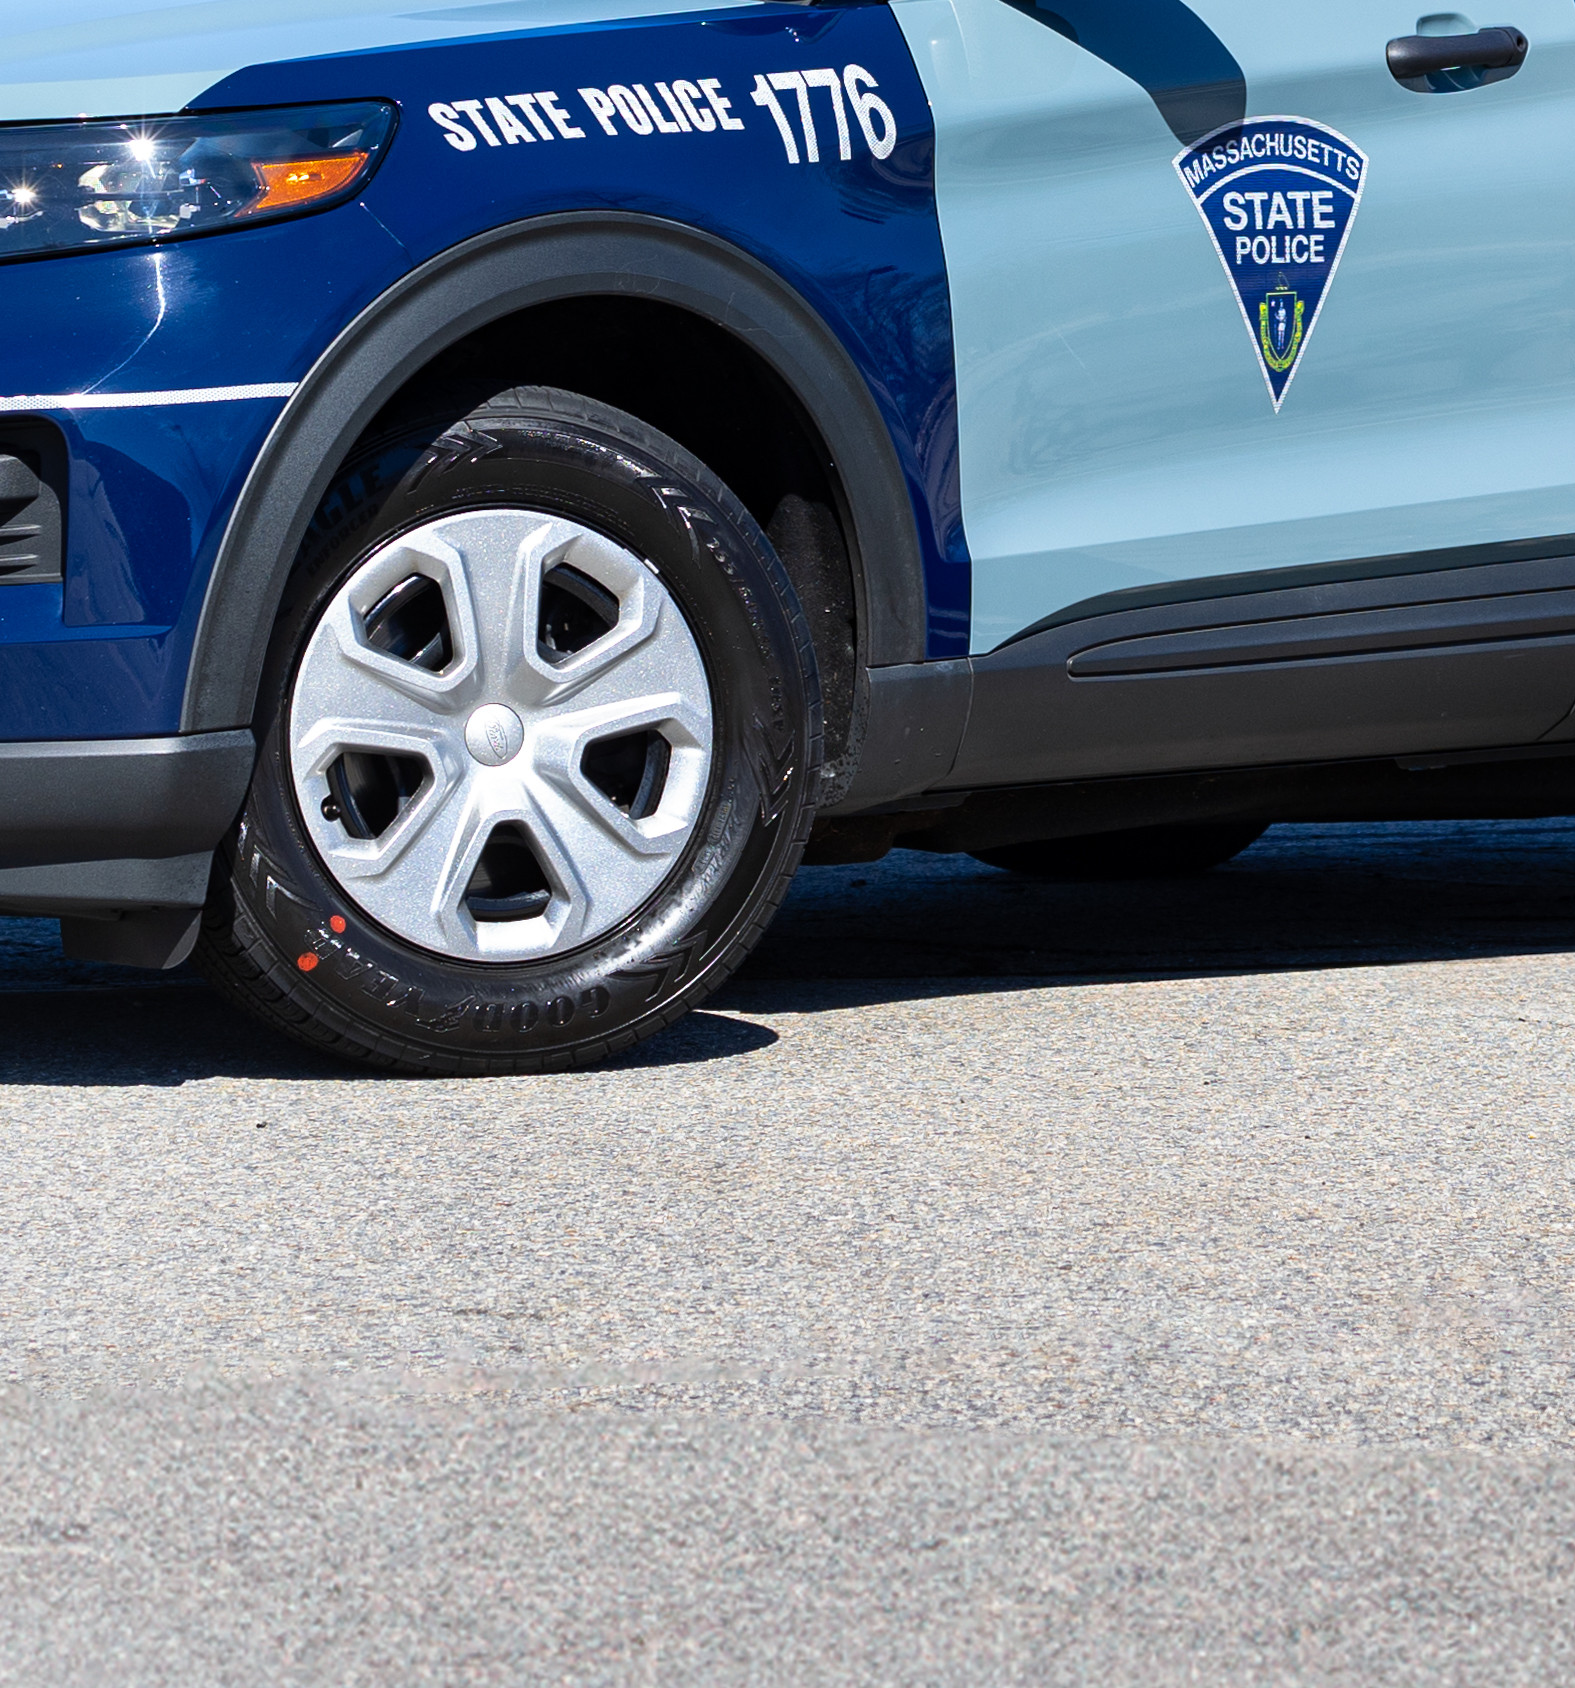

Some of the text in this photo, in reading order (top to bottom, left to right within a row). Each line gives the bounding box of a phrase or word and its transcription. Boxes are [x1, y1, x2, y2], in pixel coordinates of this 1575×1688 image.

[428, 63, 898, 165] STATE POLICE 1776
[1183, 133, 1361, 189] MASSACHUSETTS
[1222, 190, 1336, 231] STATE
[1235, 234, 1325, 265] POLICE
[303, 920, 611, 1034] GOODYEAR
